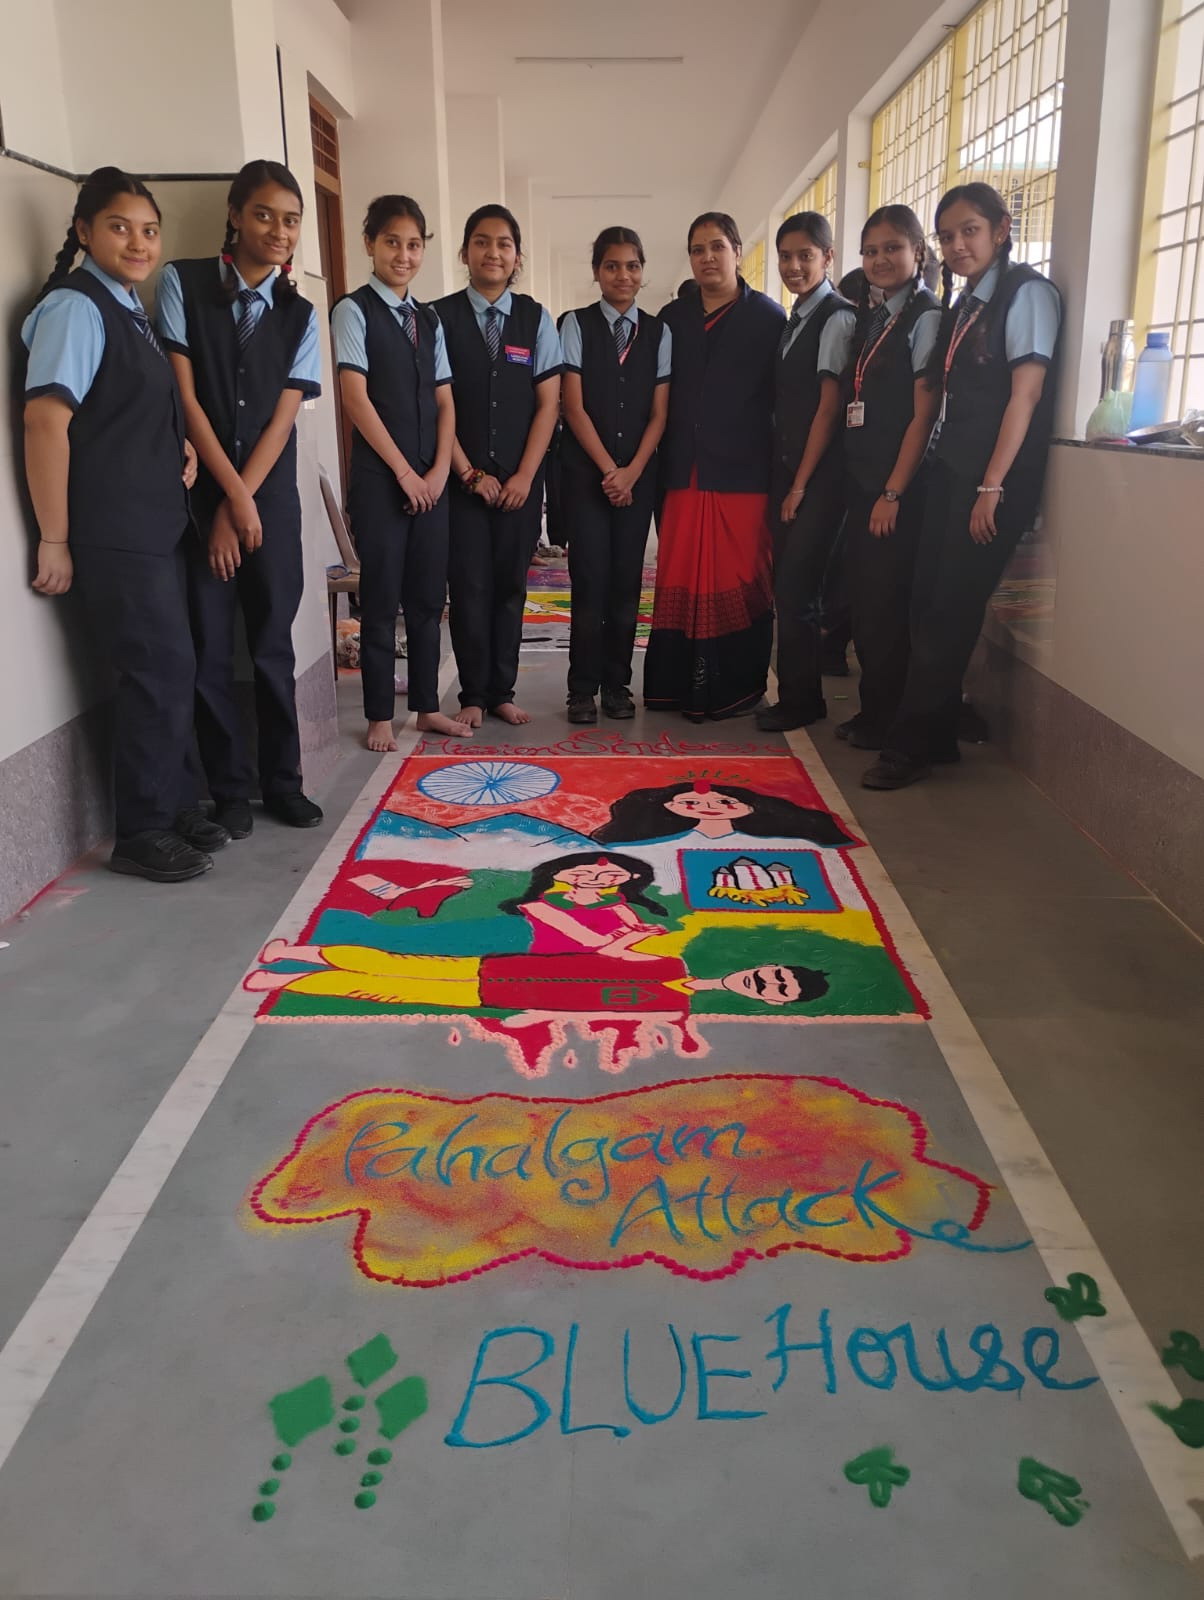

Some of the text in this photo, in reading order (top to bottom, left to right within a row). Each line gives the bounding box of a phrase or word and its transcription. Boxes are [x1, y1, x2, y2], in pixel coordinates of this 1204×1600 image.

[416, 739, 557, 756] Mission
[345, 1108, 750, 1206] Pahalgam
[608, 1160, 1035, 1253] Attack
[444, 1303, 1101, 1448] BLUE House
